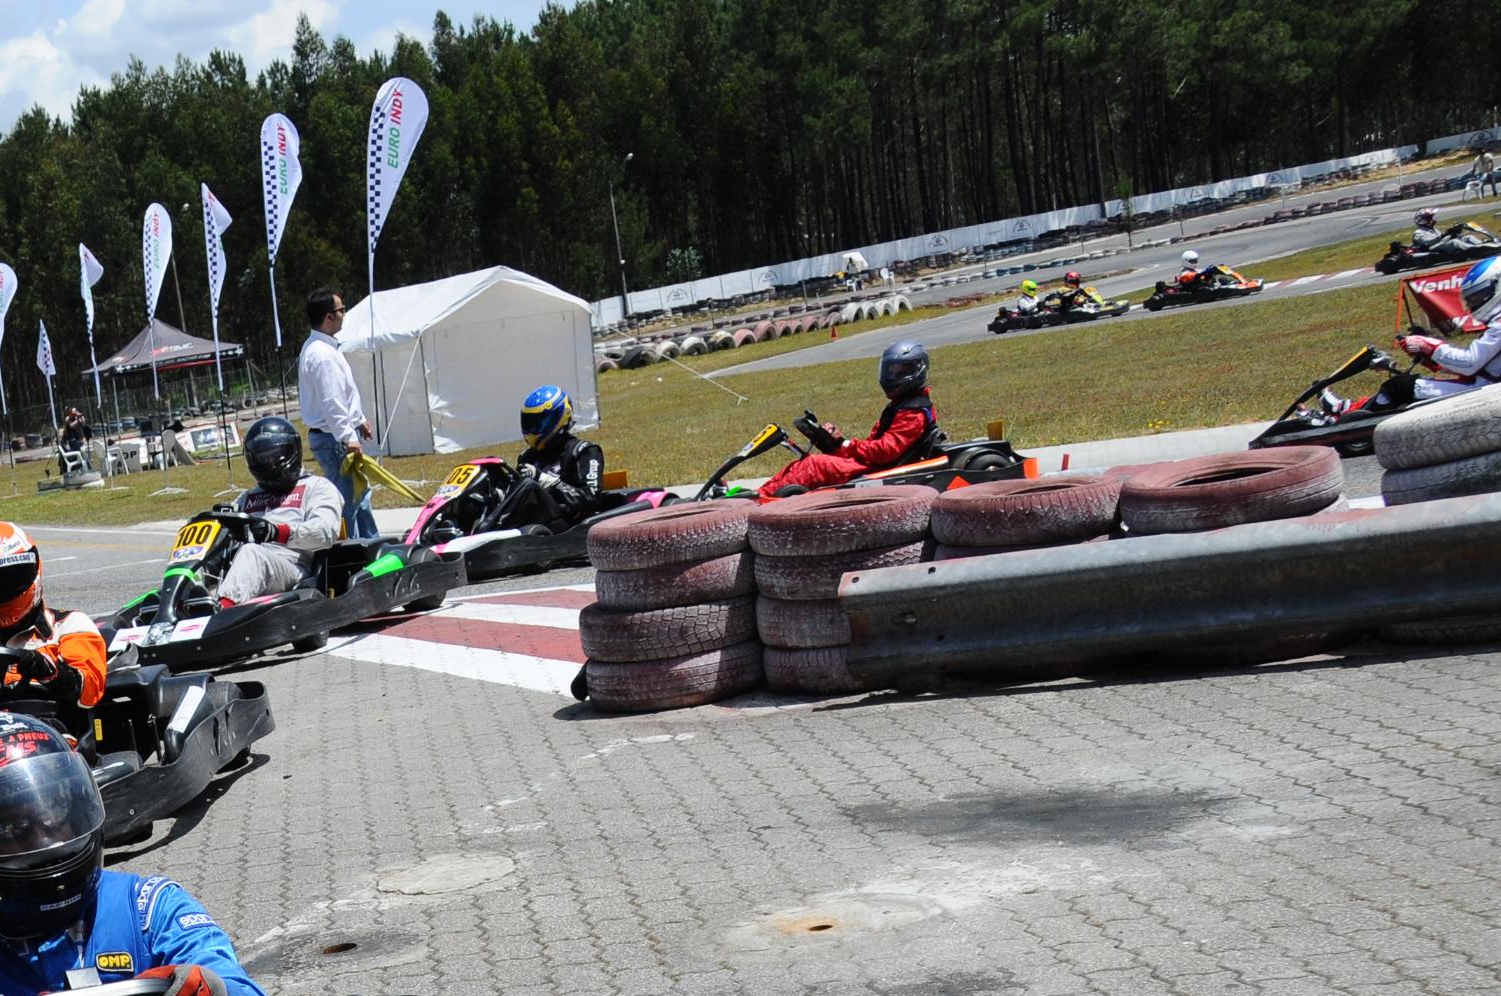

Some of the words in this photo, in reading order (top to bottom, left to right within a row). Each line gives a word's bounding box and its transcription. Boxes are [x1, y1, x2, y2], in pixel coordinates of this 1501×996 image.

[390, 88, 404, 125] INDY
[276, 123, 287, 156] INDY
[387, 127, 400, 169] EURO
[153, 211, 161, 237] INDY
[177, 524, 213, 548] 100
[99, 953, 131, 969] OMP
